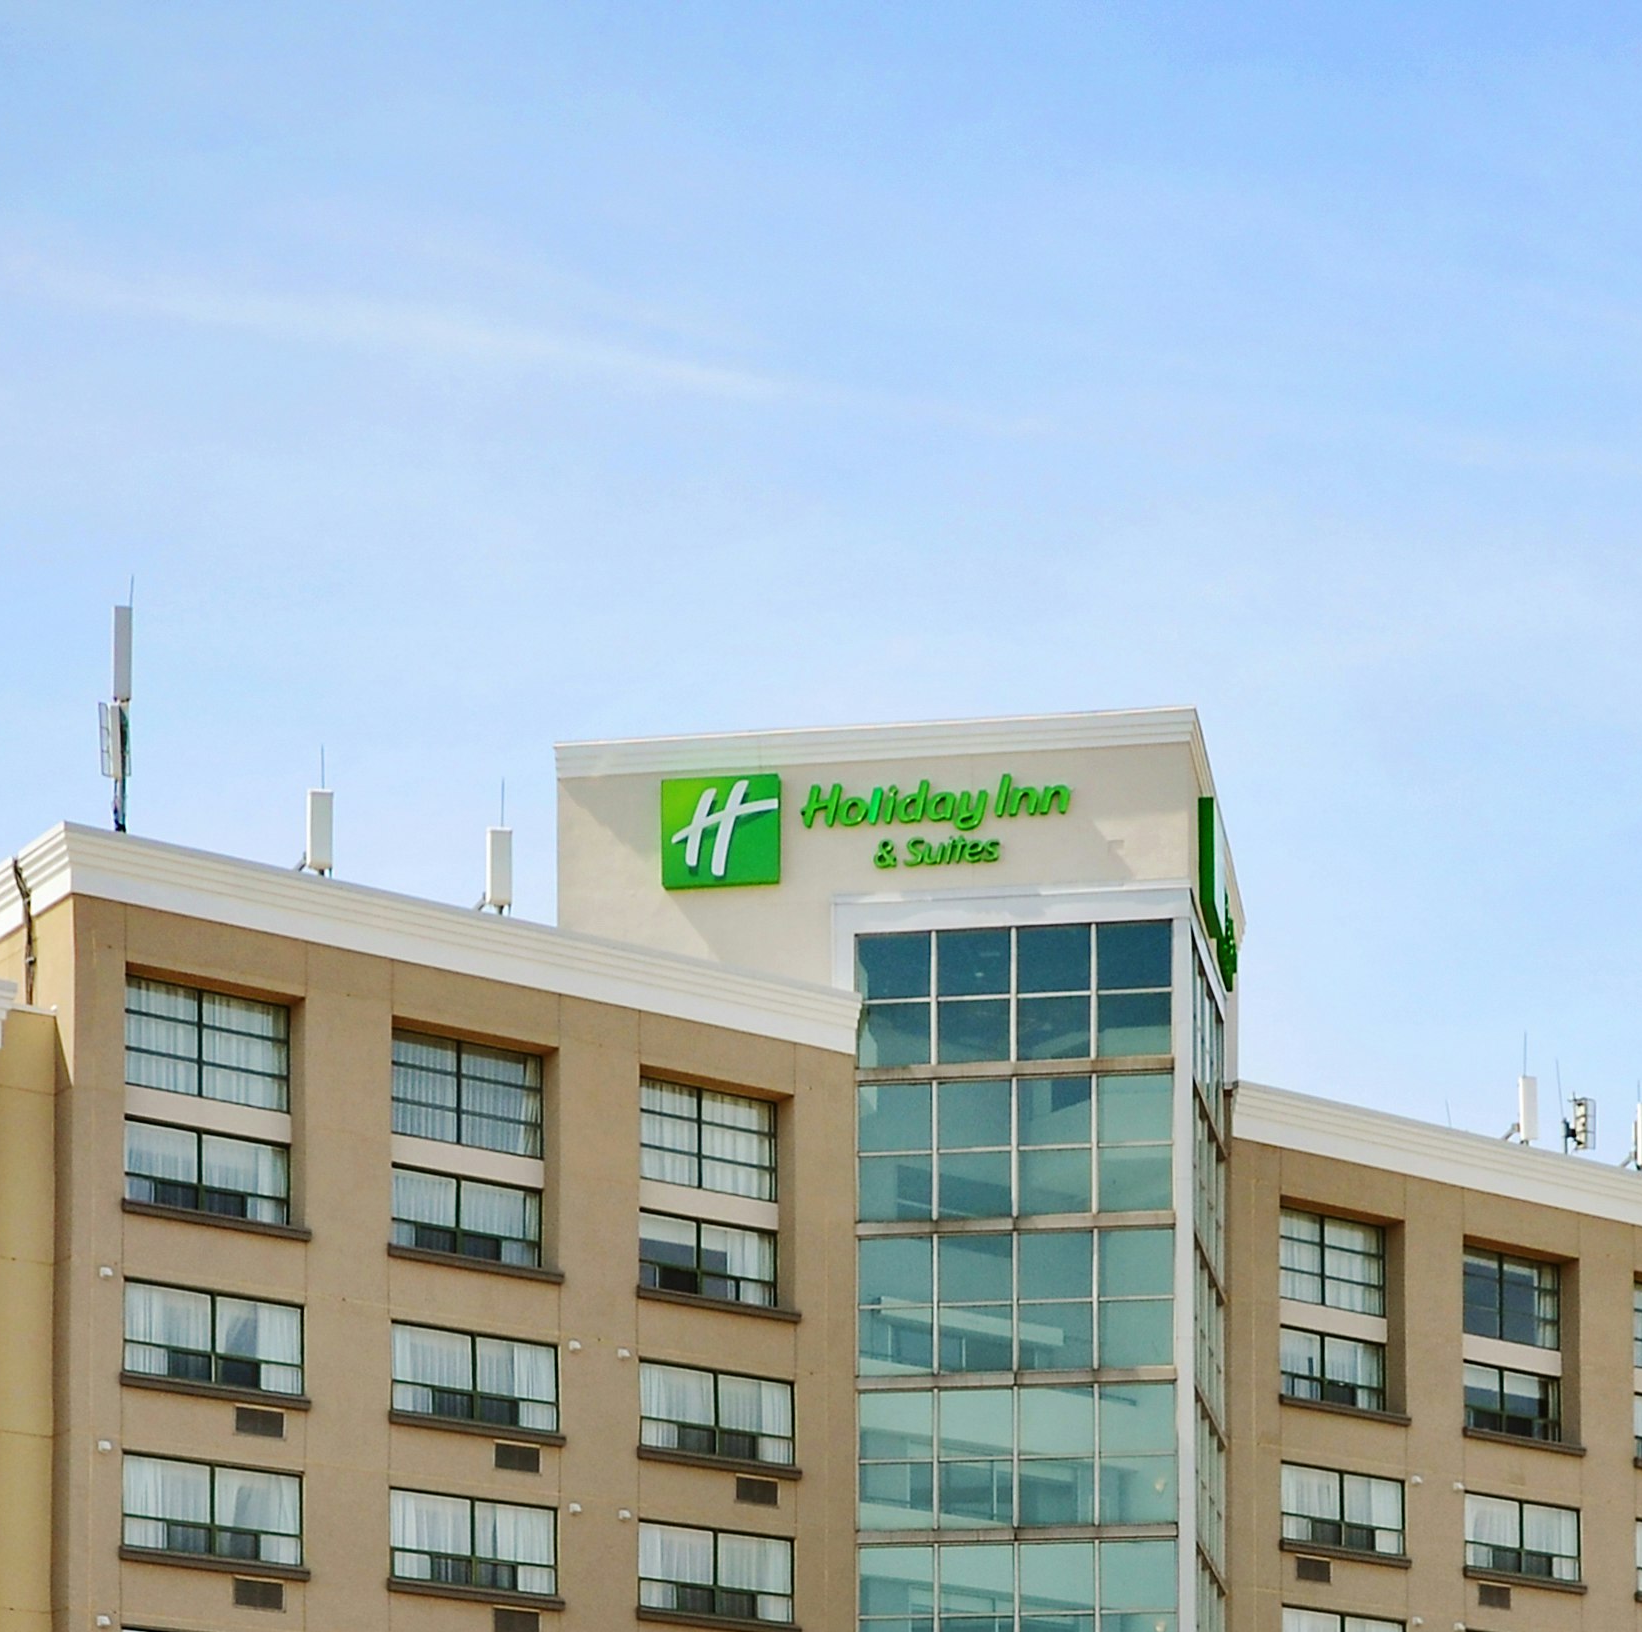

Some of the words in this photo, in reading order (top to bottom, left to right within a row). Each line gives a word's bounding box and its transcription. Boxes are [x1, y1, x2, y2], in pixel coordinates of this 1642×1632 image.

[801, 779, 988, 830] Holiday
[994, 773, 1071, 817] Inn
[873, 838, 897, 868] &
[903, 835, 1000, 867] Suites
